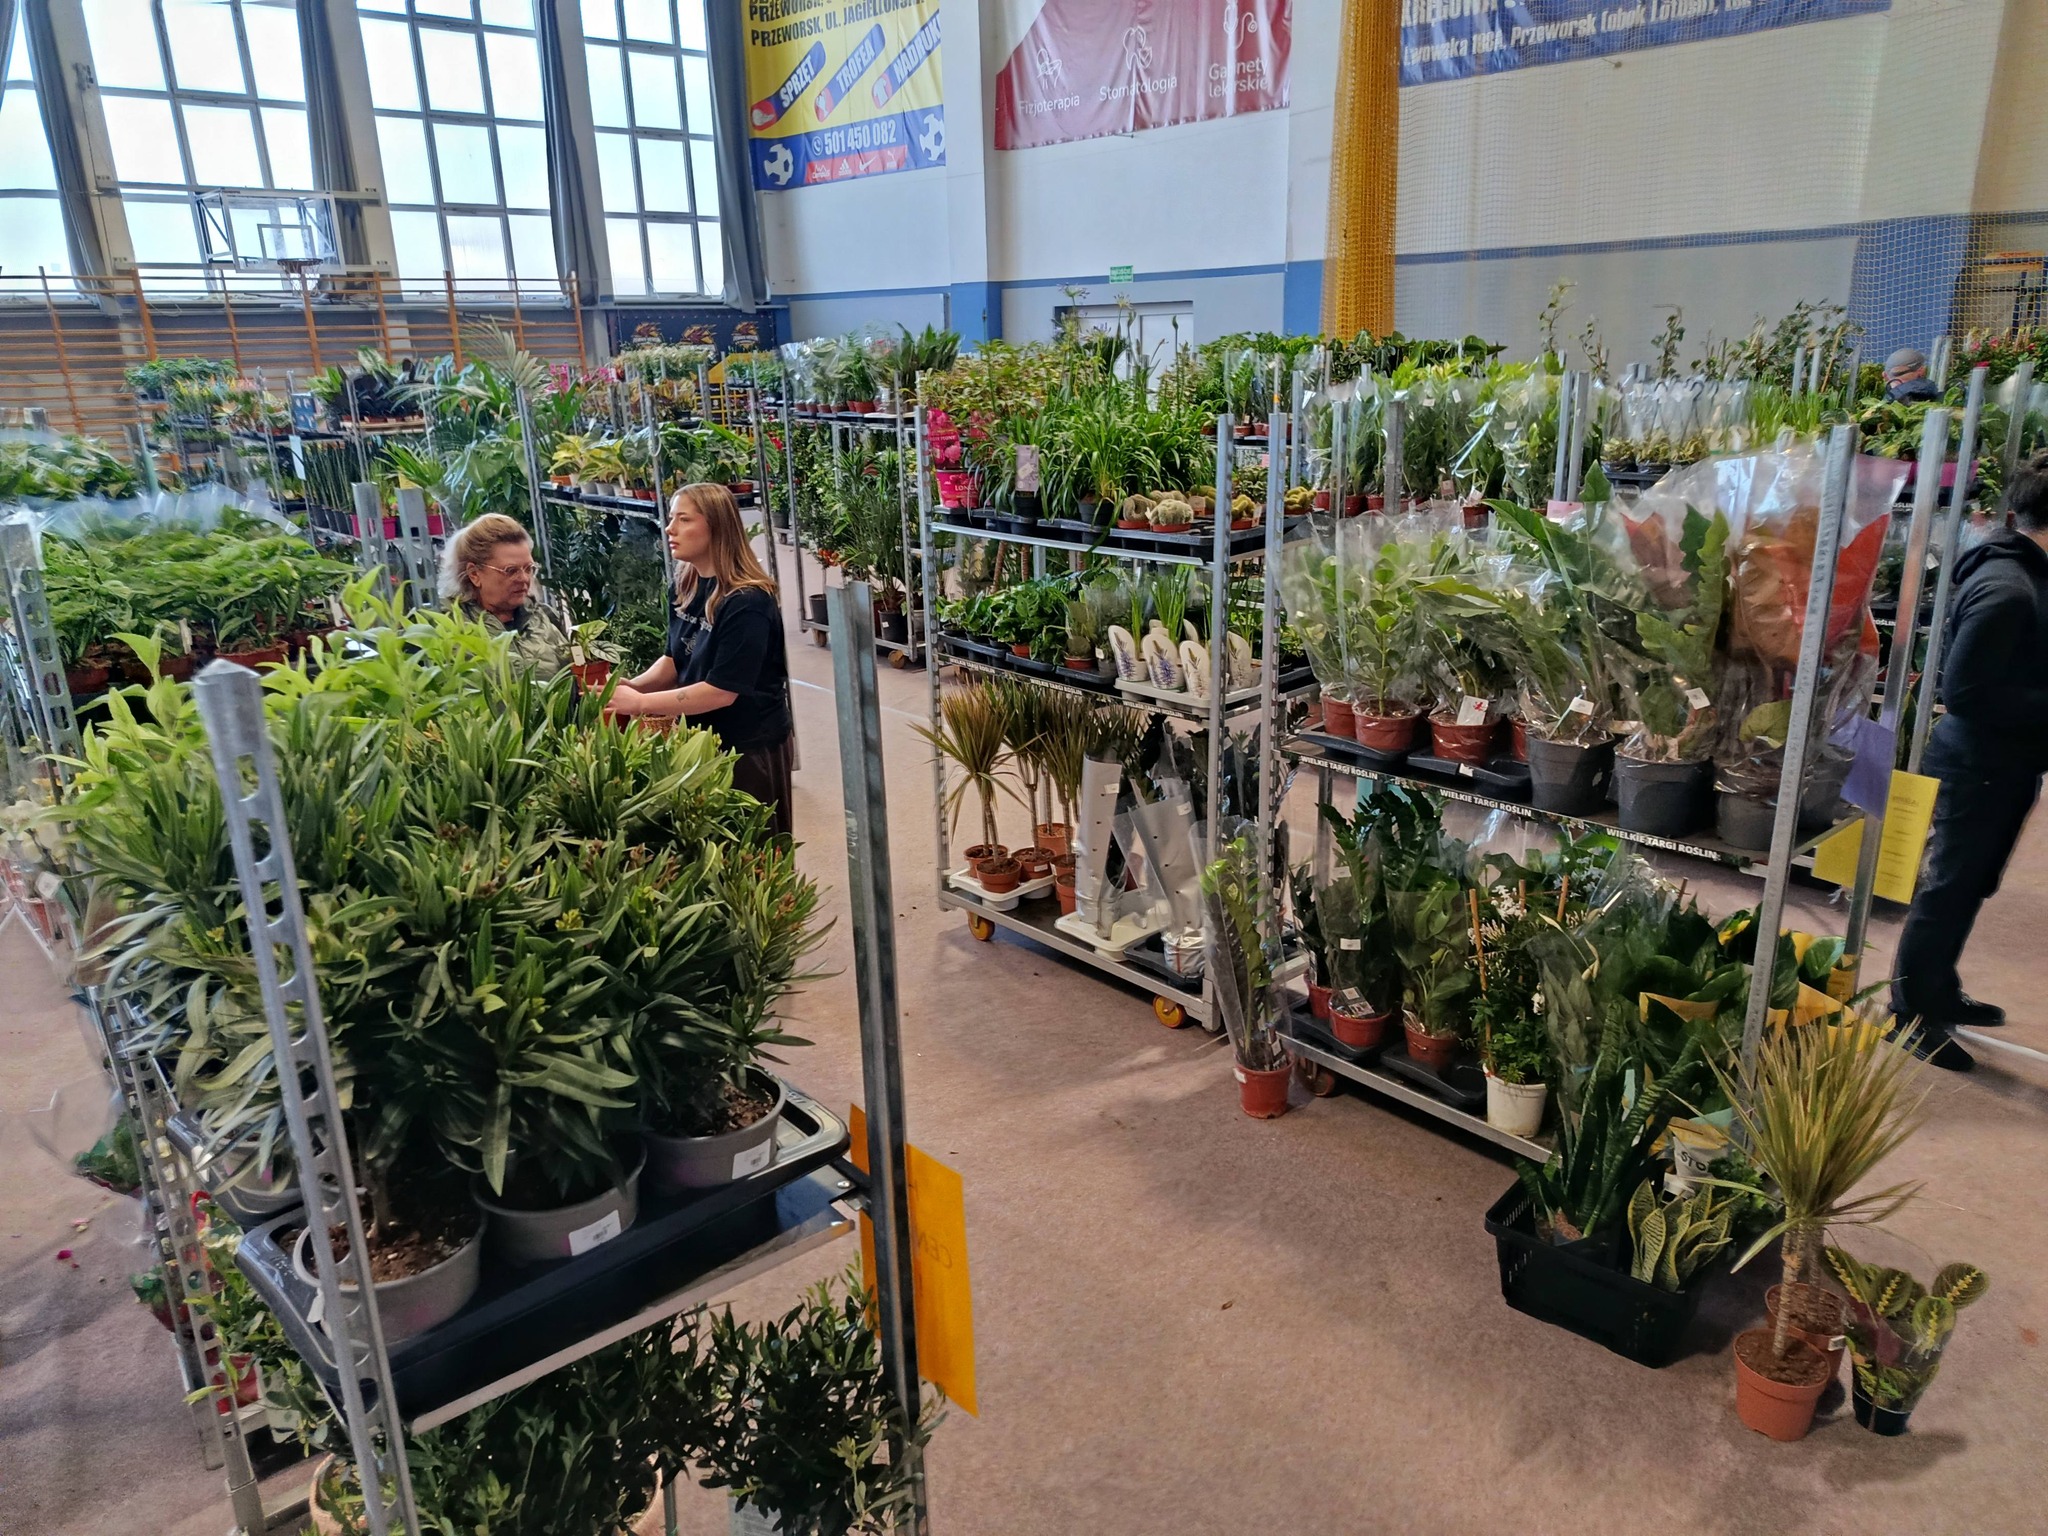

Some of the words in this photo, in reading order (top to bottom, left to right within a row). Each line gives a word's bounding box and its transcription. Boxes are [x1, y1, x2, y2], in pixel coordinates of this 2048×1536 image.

[751, 16, 824, 47] PRZEWORSK,
[825, 12, 841, 31] UL.
[1510, 14, 1597, 47] Przeworsk
[780, 54, 815, 108] SPRZĘT
[836, 39, 875, 93] TROFEA
[1019, 93, 1080, 115] Fizjoterapia
[1100, 75, 1177, 100] Stomatologia
[824, 131, 846, 156] 501
[848, 126, 870, 149] 450
[872, 119, 896, 146] 082
[1300, 755, 1328, 768] WIELKIE
[1351, 767, 1378, 780] ROŚLIN
[1440, 789, 1472, 803] WIELKIE
[1473, 796, 1498, 809] TARGI
[1500, 803, 1532, 817] ROŚLIN
[1606, 828, 1645, 843] WIELKIE
[1646, 837, 1677, 851] TARGI
[1678, 844, 1718, 861] ROŚLIN
